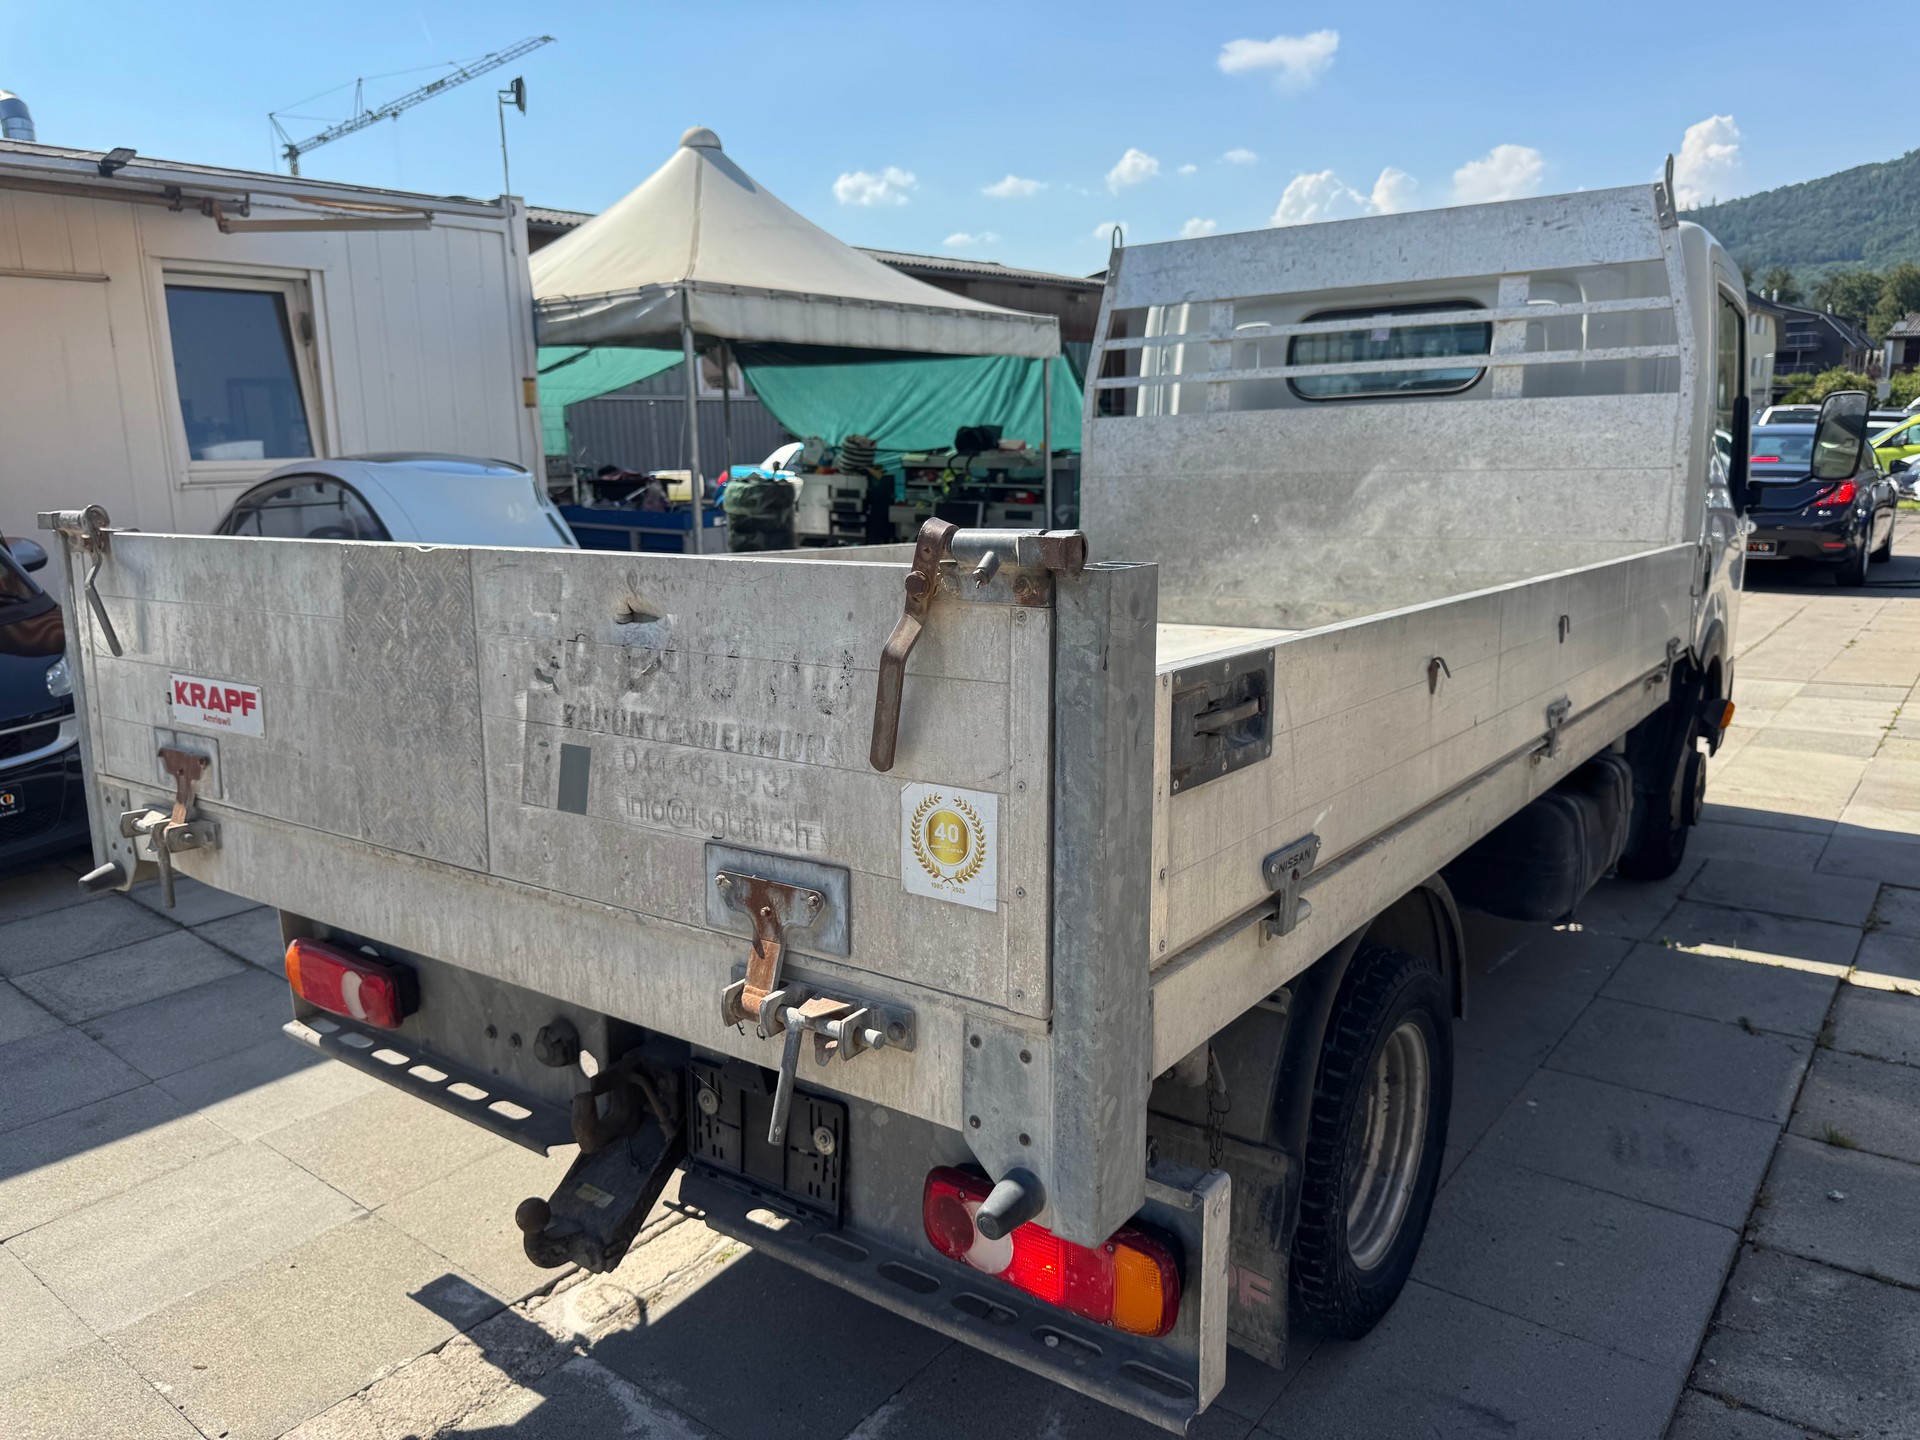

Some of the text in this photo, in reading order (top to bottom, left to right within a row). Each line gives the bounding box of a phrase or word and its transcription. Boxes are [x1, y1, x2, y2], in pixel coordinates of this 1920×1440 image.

[174, 680, 256, 716] KRAPF
[934, 822, 959, 844] 40
[1278, 847, 1311, 875] NISSAN
[930, 882, 944, 890] 1985
[952, 886, 966, 894] 2025
